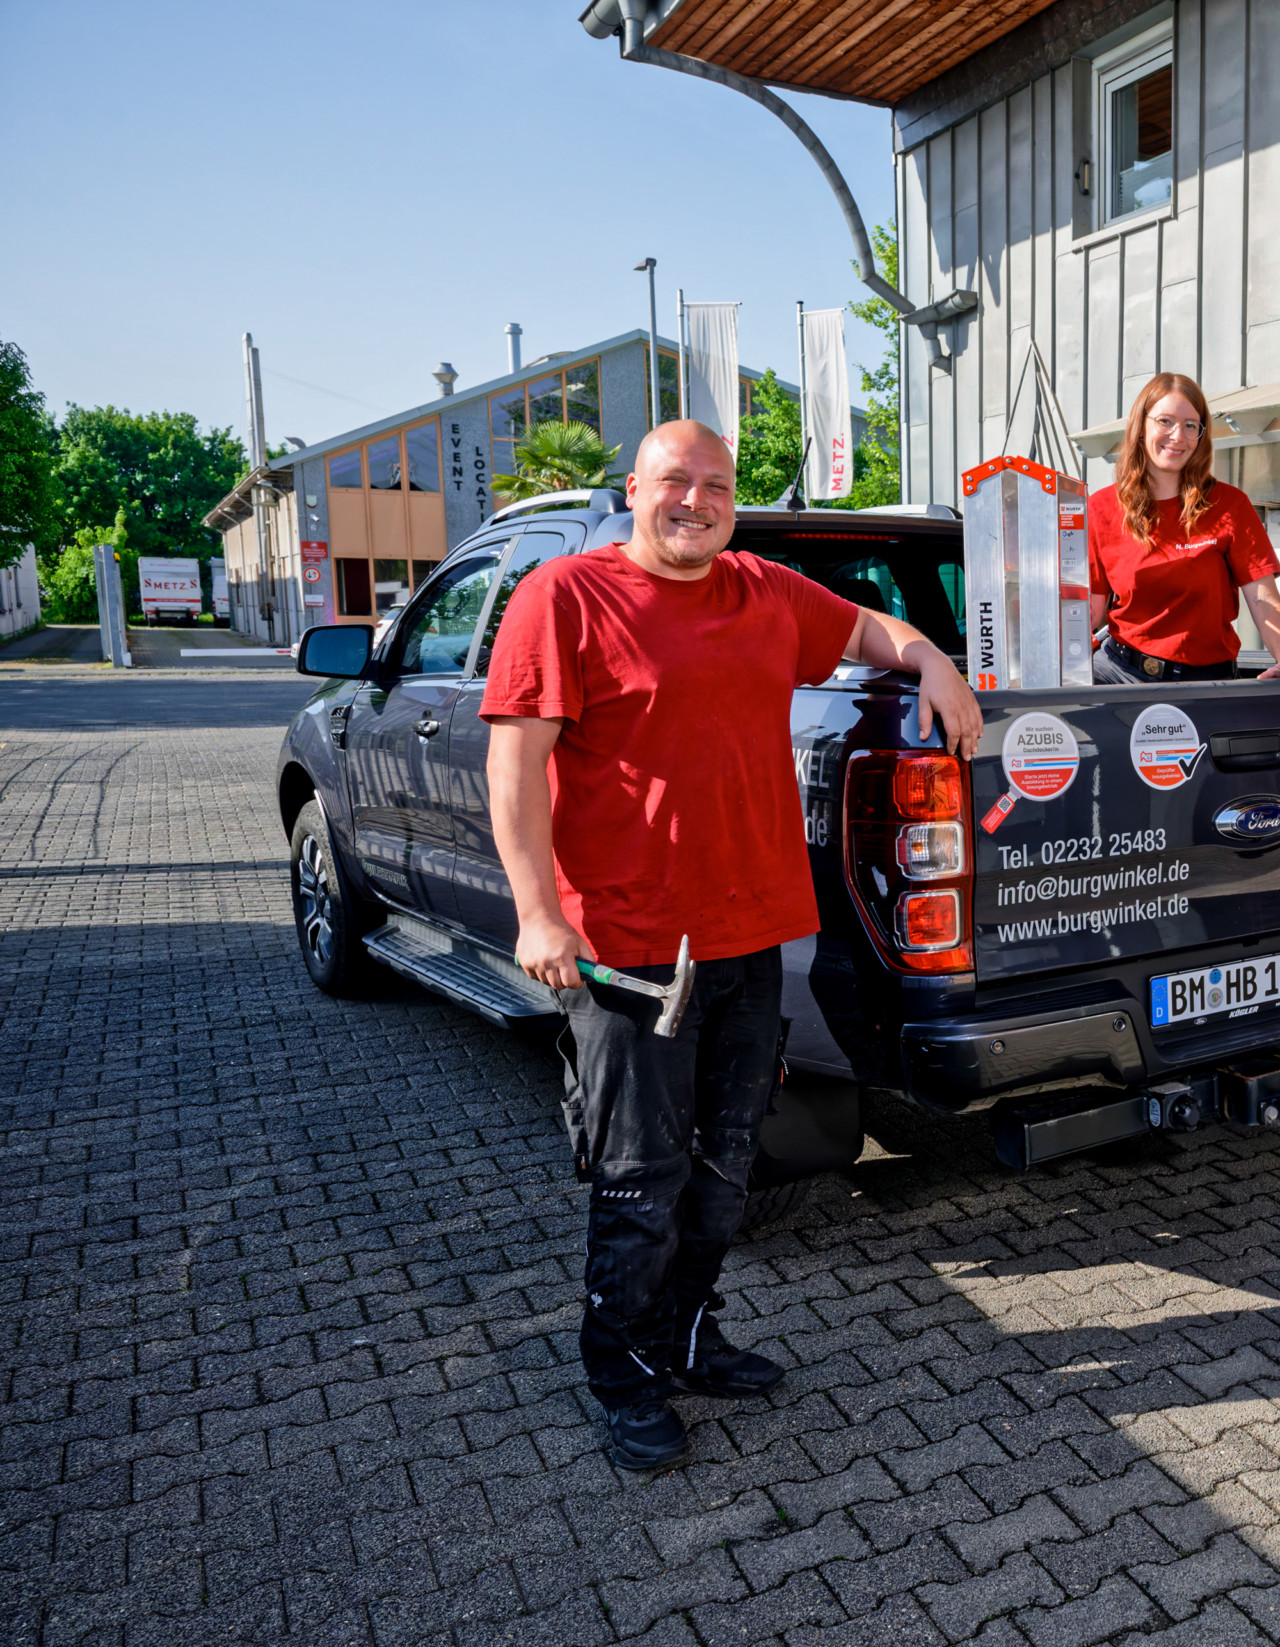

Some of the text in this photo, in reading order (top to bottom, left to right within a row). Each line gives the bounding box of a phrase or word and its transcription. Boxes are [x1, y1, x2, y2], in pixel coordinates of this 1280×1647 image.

[451, 423, 463, 491] EVENT
[980, 602, 994, 669] WÜRTH
[1017, 733, 1064, 746] AZUBIS
[792, 748, 829, 788] KEL
[1247, 809, 1280, 830] Ford
[998, 828, 1167, 870] Tel. 02232 25483
[997, 859, 1190, 906] info@burgwinkel.de
[997, 893, 1189, 943] www.burgwinkel.de
[1156, 1007, 1163, 1018] D
[1171, 976, 1206, 1017] BM
[1226, 965, 1258, 1005] HB
